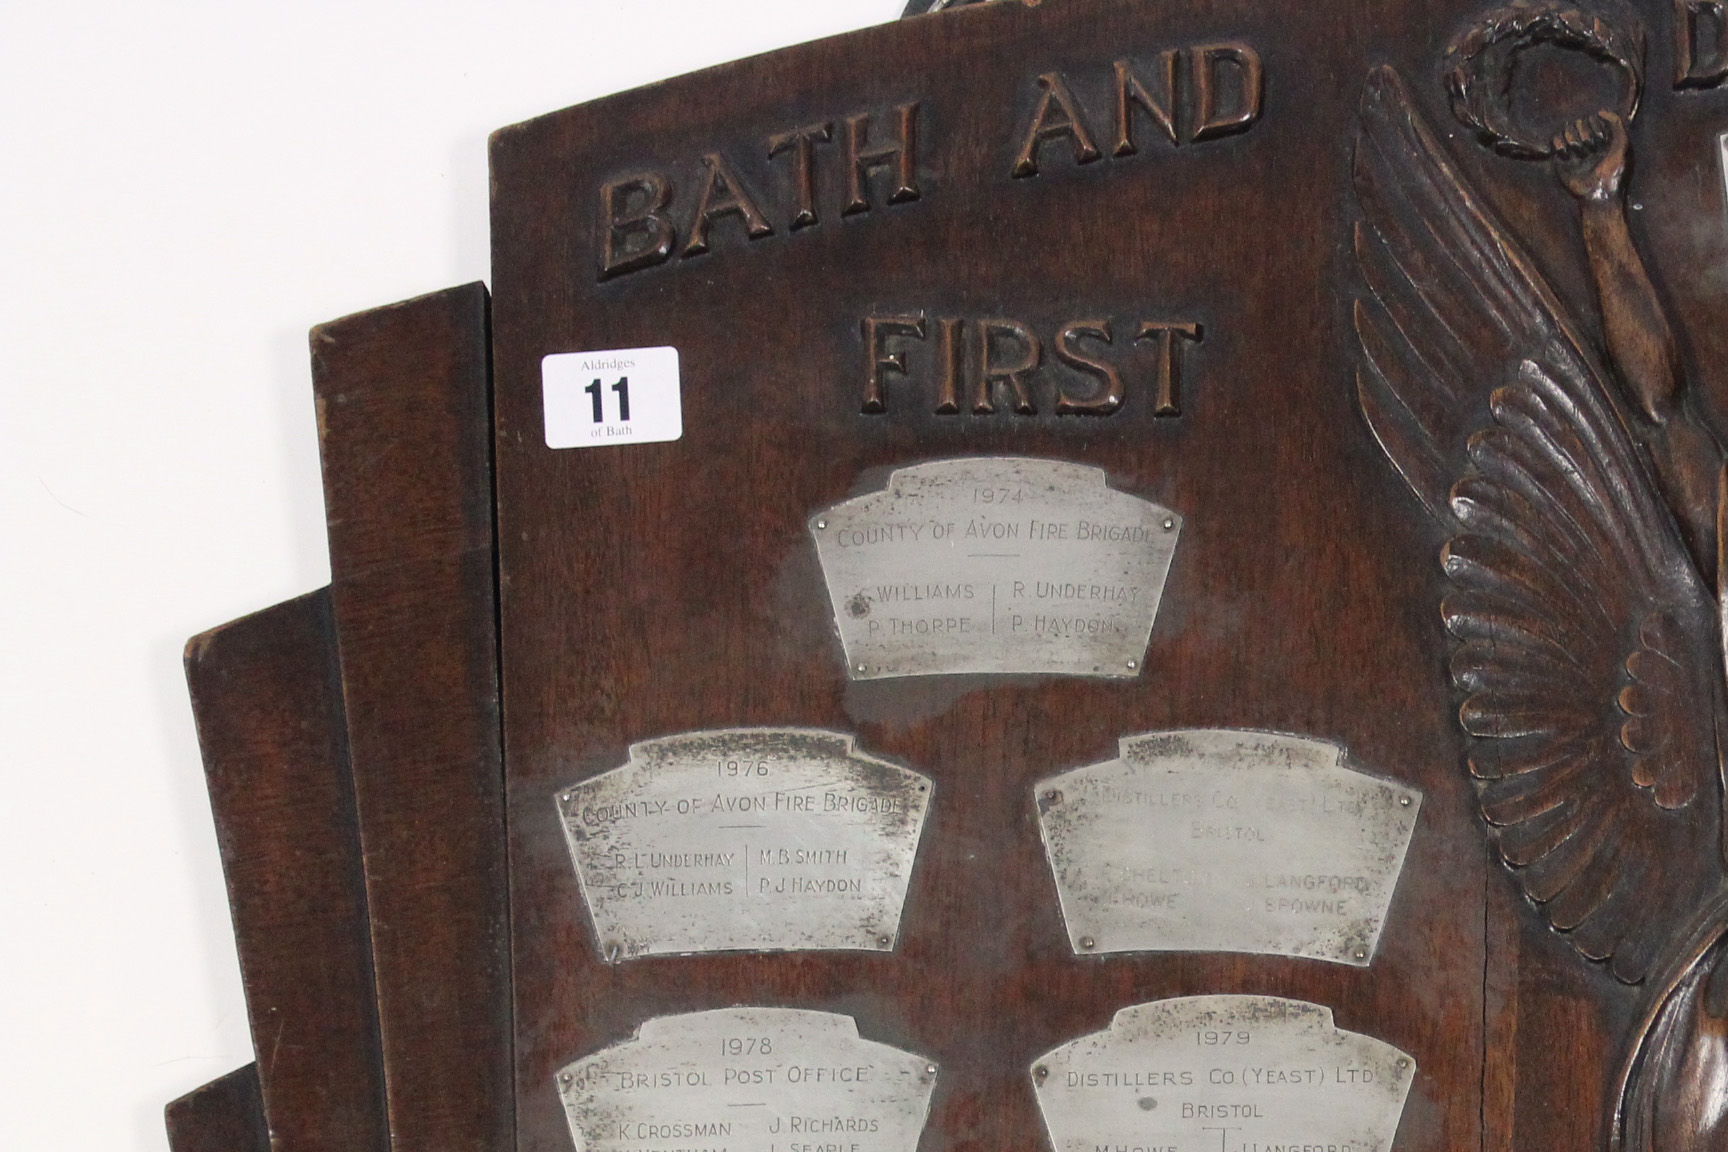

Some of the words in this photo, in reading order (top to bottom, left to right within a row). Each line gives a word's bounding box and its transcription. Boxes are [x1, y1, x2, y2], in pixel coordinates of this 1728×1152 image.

[600, 101, 920, 283] BATH
[1012, 39, 1265, 178] AND
[581, 358, 636, 372] Aldridges
[859, 314, 1203, 418] FIRST
[584, 376, 630, 423] 11
[590, 427, 602, 438] of
[606, 424, 633, 437] Bath
[973, 488, 1023, 504] 1974
[932, 523, 955, 539] OF
[965, 519, 1018, 539] AVON
[1030, 520, 1067, 540] FIRE
[718, 760, 769, 777] 1976
[677, 799, 701, 814] OF
[711, 793, 767, 812] AVON
[775, 792, 815, 812] FIRE
[721, 1038, 772, 1056] 1978
[1197, 1031, 1250, 1046] 1979
[621, 1071, 711, 1089] BRISTOL
[725, 1068, 777, 1085] POST
[788, 1067, 869, 1083] OFFICE
[1182, 1103, 1263, 1119] BRISTOL
